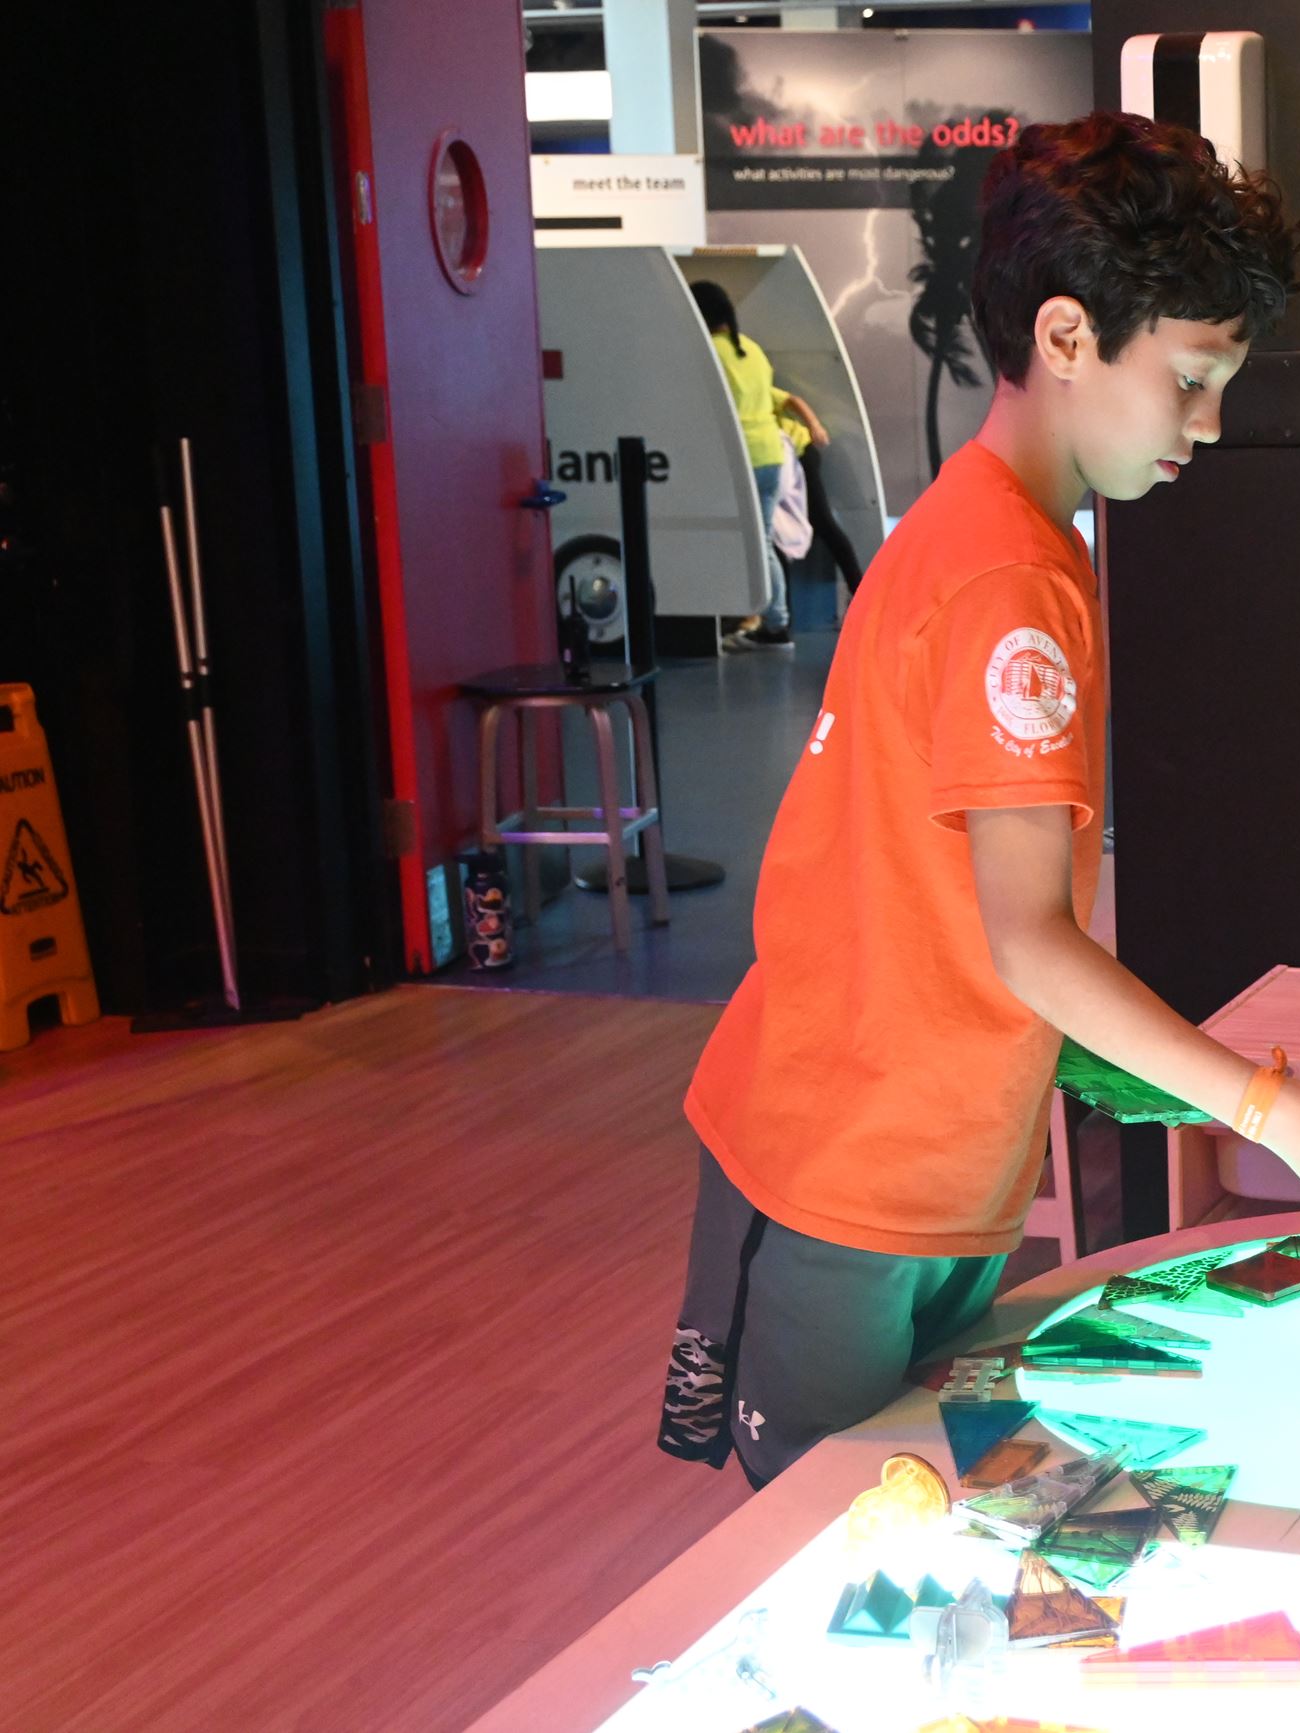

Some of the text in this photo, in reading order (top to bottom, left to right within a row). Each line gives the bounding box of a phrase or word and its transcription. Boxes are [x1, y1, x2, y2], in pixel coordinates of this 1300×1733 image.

[730, 116, 1019, 148] what are the odds?
[573, 175, 686, 190] meet the team
[732, 165, 955, 183] what activities are most dangerous?
[0, 767, 46, 793] AUTION
